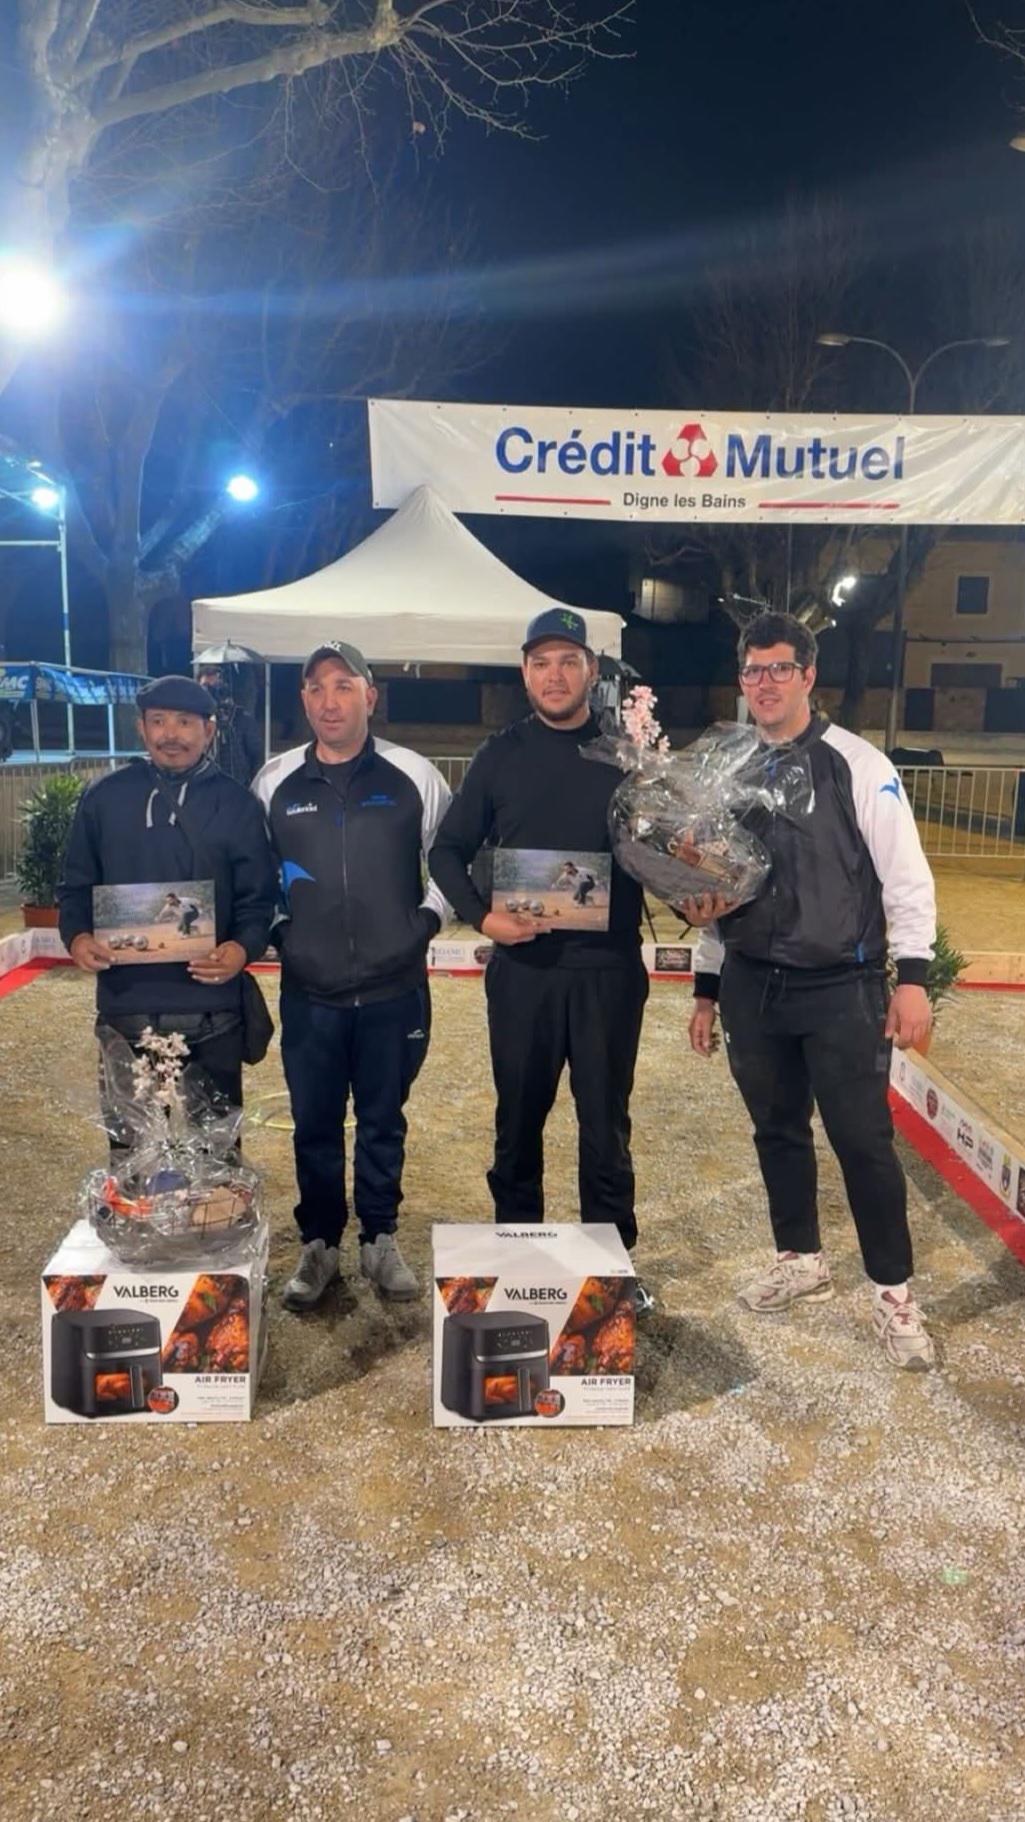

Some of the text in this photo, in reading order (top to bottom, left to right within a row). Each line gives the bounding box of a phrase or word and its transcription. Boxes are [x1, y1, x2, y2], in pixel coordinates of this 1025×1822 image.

[495, 426, 904, 482] Crédit Mutuel
[623, 492, 746, 509] Digne les Bains
[113, 1285, 179, 1299] VALBERG
[503, 1287, 568, 1301] VALBERG
[194, 1375, 246, 1384] AIR FRYER
[581, 1377, 632, 1386] AIR FRYER
